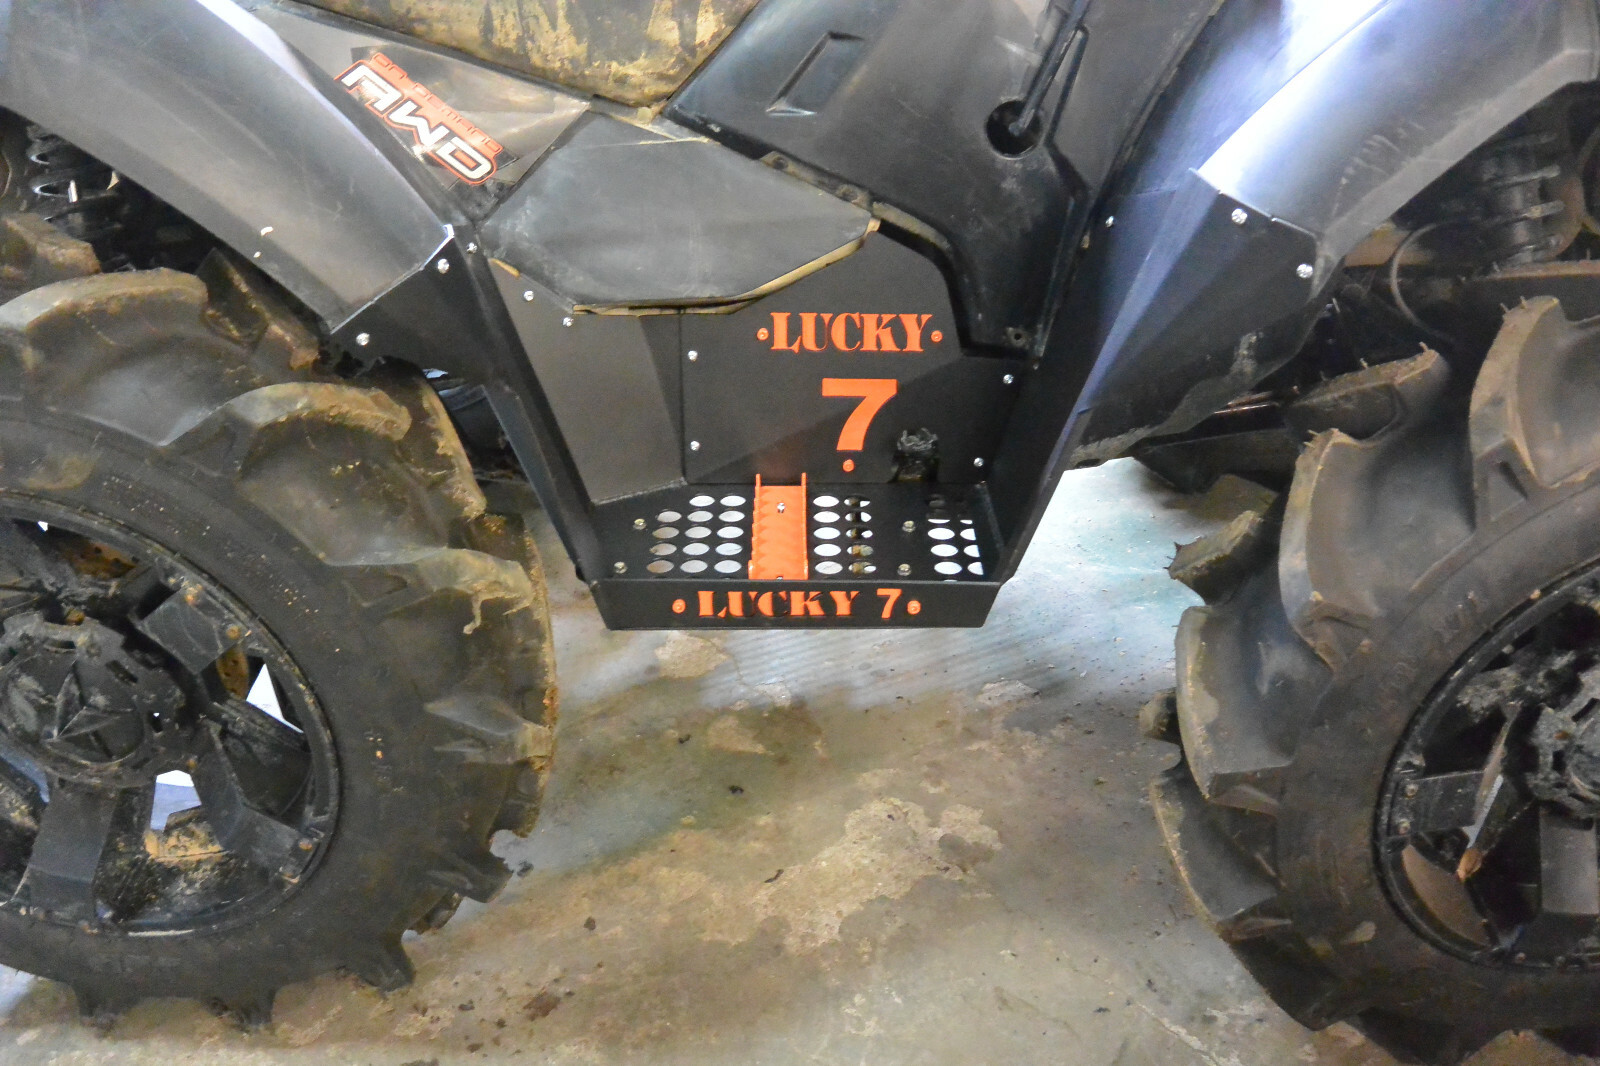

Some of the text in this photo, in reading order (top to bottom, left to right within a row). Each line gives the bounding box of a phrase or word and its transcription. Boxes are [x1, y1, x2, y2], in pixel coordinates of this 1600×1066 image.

[341, 64, 492, 179] AWD
[770, 312, 933, 355] LUCKY
[821, 378, 898, 451] 7
[697, 588, 903, 619] LUCKY 7
